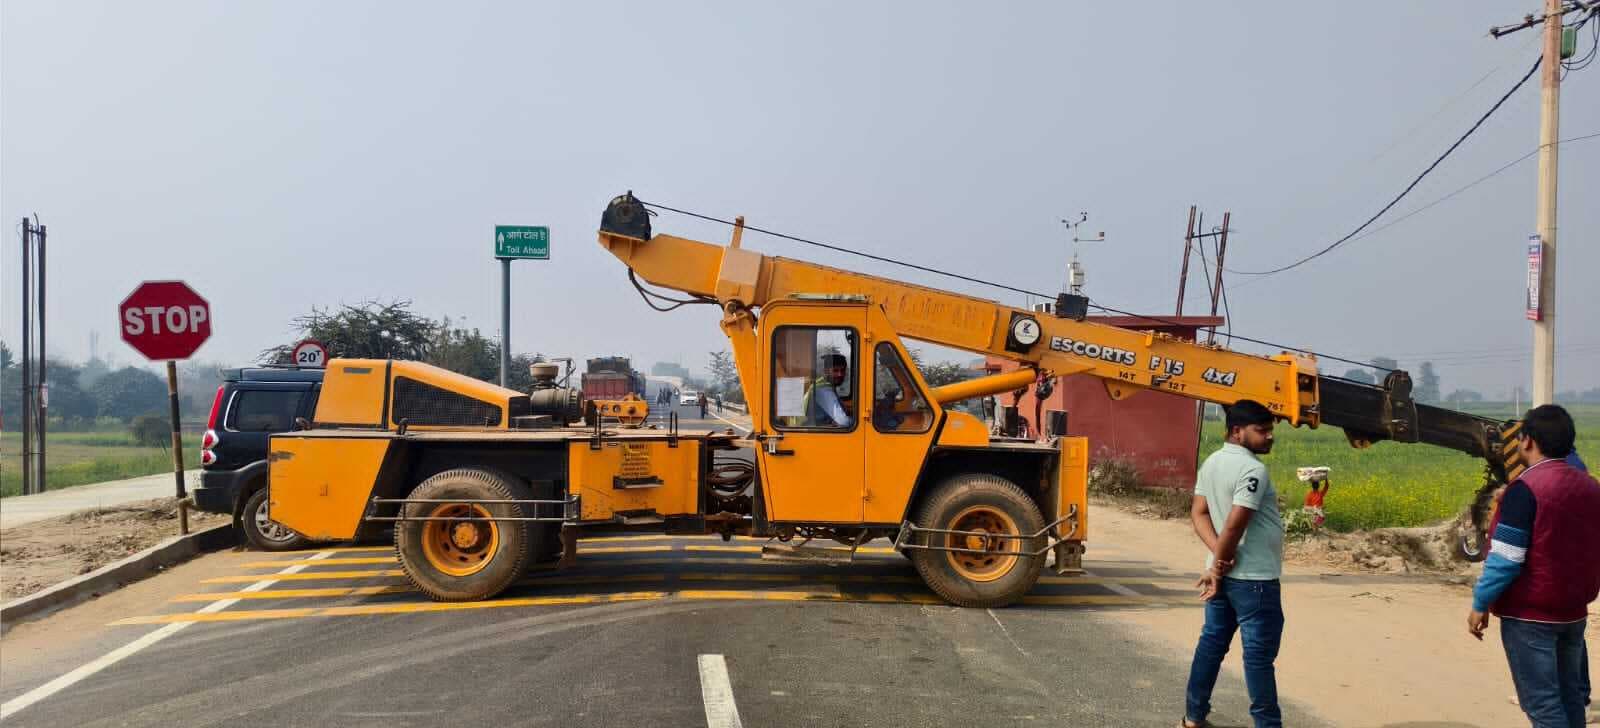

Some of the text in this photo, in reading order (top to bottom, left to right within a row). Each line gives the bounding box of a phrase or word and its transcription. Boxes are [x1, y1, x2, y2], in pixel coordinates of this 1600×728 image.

[505, 245, 547, 254] Toll Ahead
[125, 305, 207, 336] STOP
[1050, 336, 1136, 366] ESCORTS
[1248, 477, 1259, 493] 3
